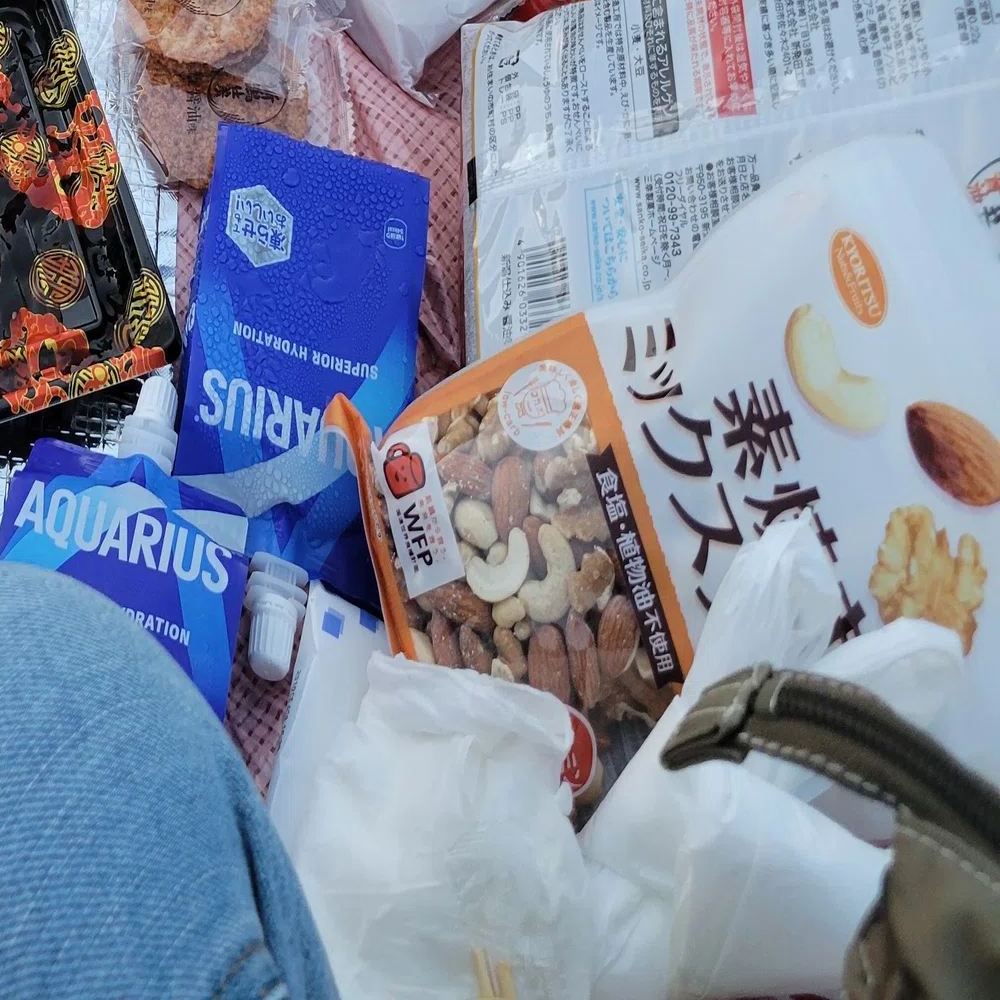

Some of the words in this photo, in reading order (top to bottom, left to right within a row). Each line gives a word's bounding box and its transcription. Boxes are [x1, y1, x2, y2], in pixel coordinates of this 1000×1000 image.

[630, 23, 645, 78] 小麦・大豆
[633, 176, 651, 291] www.sanko-seika.co.jp
[643, 174, 660, 265] 三幸製菓ホームページ
[663, 171, 681, 256] 0120-99-7343
[674, 169, 688, 228] フリーダイヤル
[514, 254, 528, 296] 901626
[842, 231, 883, 320] KYORITSU
[232, 320, 309, 360] HYDRATION
[517, 302, 529, 332] 0332
[312, 350, 379, 380] SUPERIOR
[622, 316, 743, 595] ミックス
[13, 479, 232, 595] AQUARIUS
[398, 502, 437, 569] WFP
[595, 466, 677, 676] 食塩・植物油不使用
